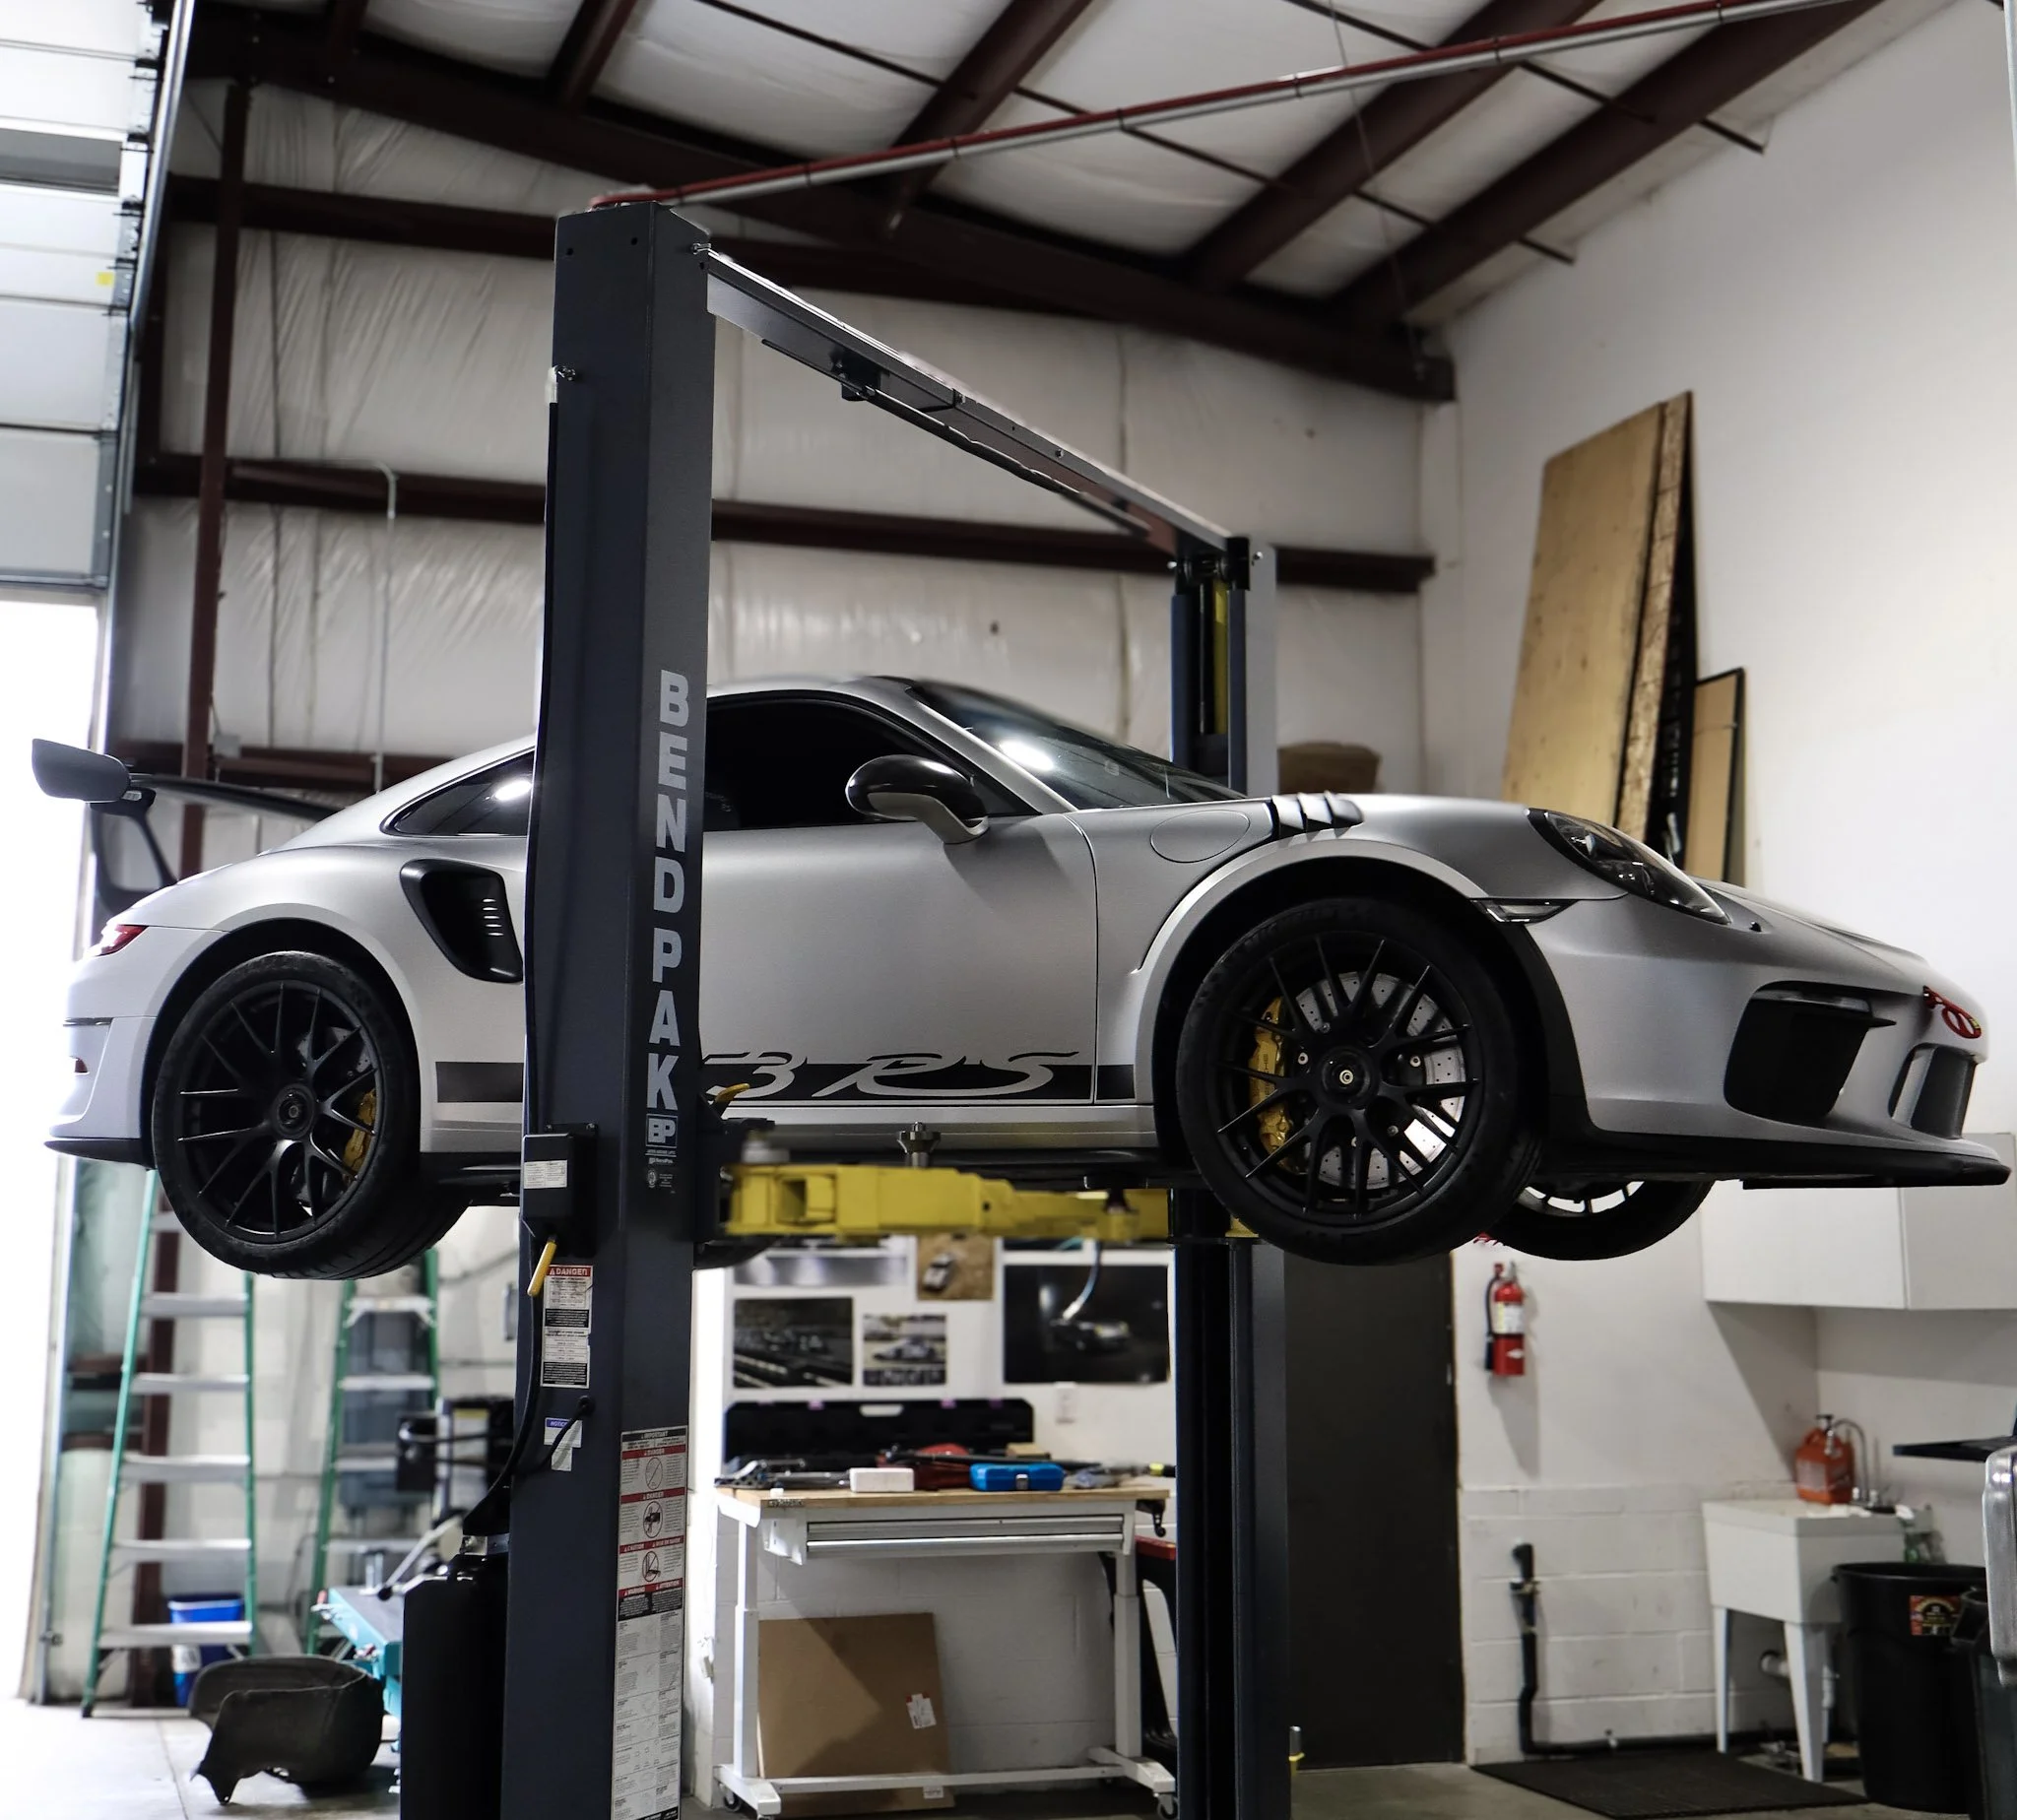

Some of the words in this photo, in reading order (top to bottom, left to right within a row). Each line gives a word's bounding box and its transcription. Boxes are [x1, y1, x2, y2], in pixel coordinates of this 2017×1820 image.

[646, 669, 689, 1111] BENDPAK
[812, 1051, 1079, 1098] RS
[647, 1118, 677, 1143] BP
[555, 1268, 589, 1276] DANGER
